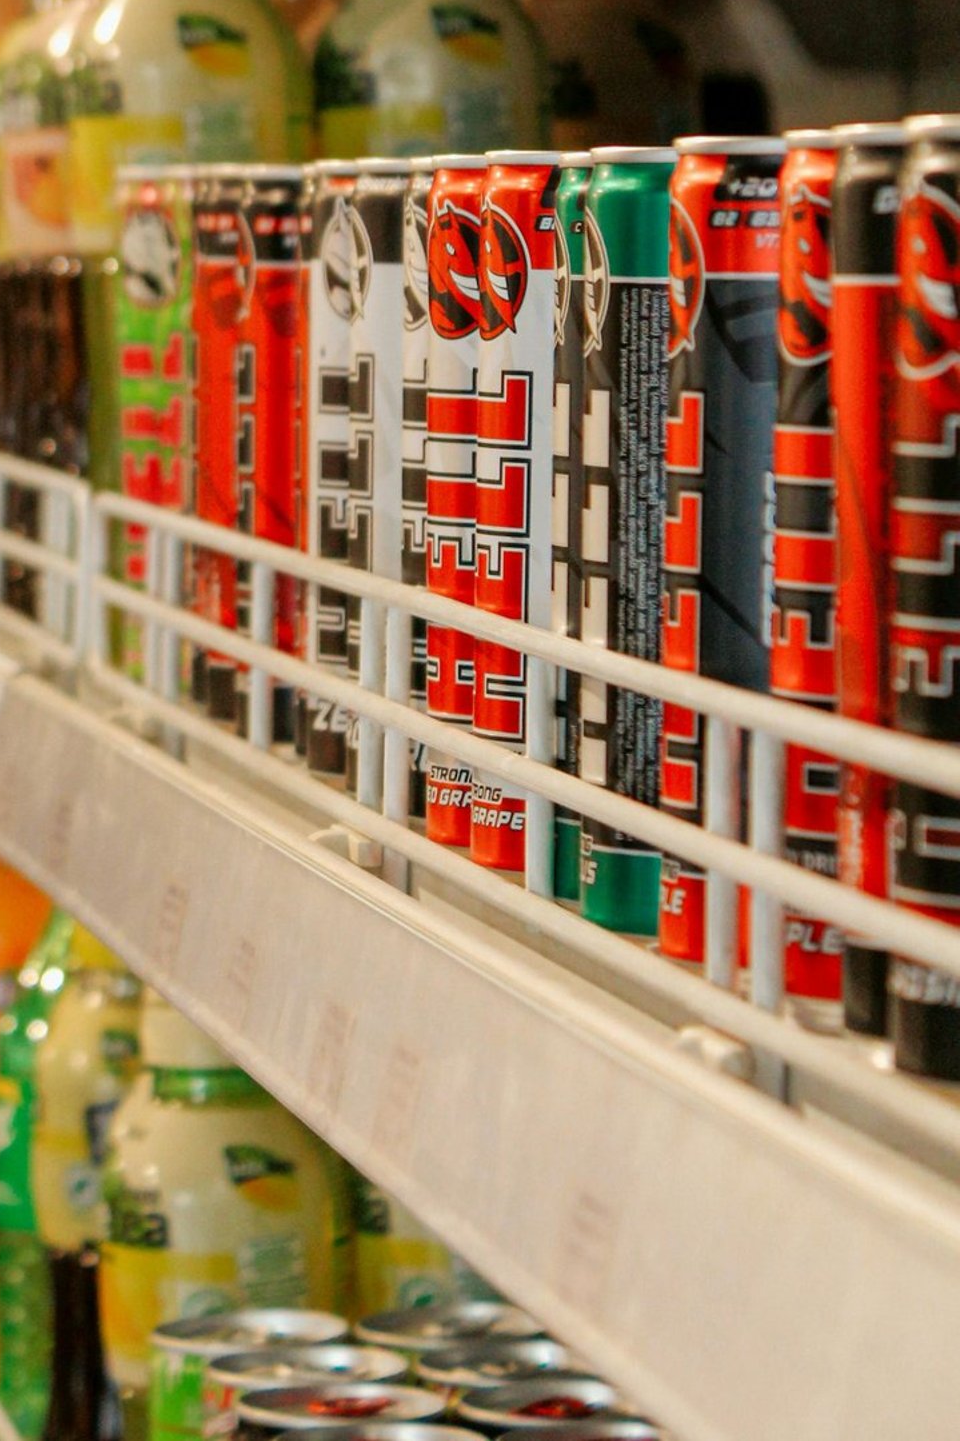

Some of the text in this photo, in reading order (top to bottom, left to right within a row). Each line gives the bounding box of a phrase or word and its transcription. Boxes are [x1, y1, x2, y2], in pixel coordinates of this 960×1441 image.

[473, 370, 533, 744] HELL
[431, 765, 473, 783] STRON
[439, 788, 473, 808] GRA
[473, 806, 525, 831] GRAPE
